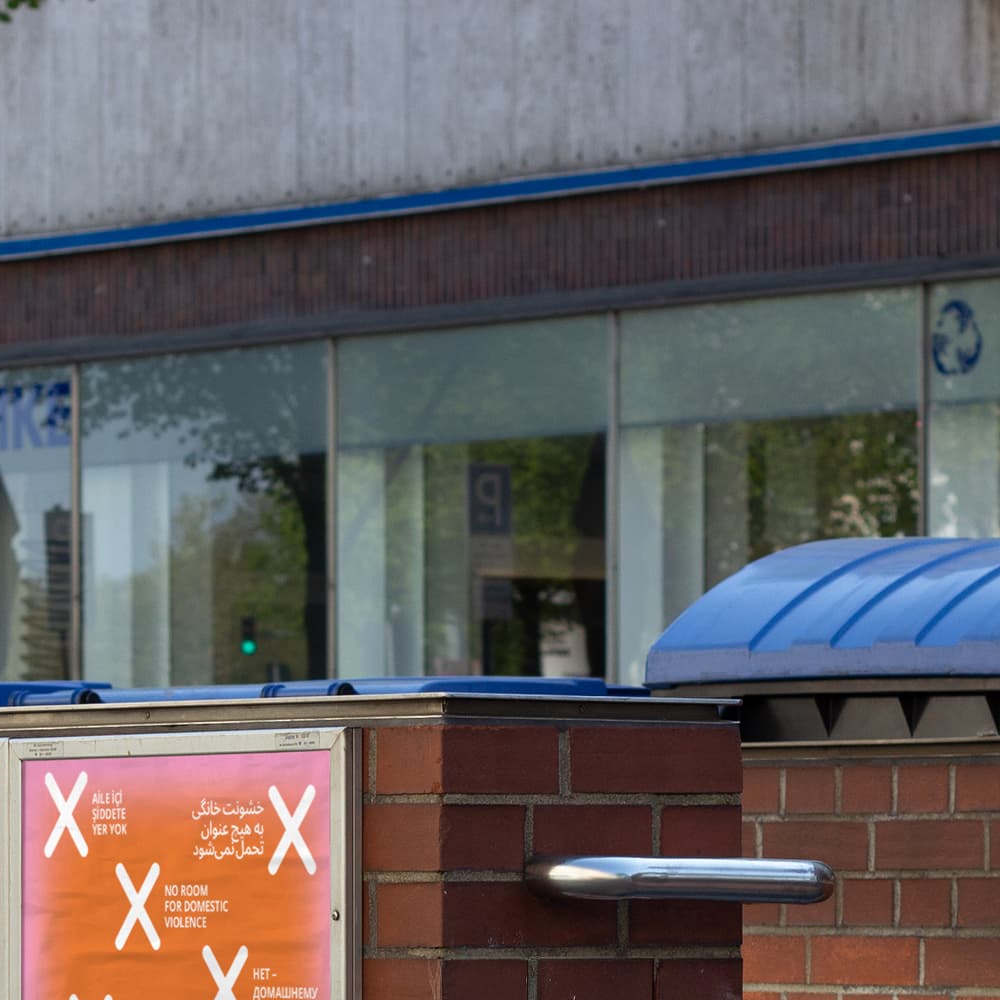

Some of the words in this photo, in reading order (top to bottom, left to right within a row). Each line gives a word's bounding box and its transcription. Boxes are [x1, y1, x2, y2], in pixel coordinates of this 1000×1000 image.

[92, 824, 108, 836] YER
[109, 824, 127, 836] YOK
[164, 884, 178, 896] NO
[180, 884, 208, 896] ROOM
[164, 900, 182, 912] FOR
[184, 900, 229, 913] DOMESTIC
[164, 916, 207, 929] VIOLENCE
[253, 968, 270, 980] НЕТ
[253, 986, 319, 1000] ДОМАШНЕМУ
